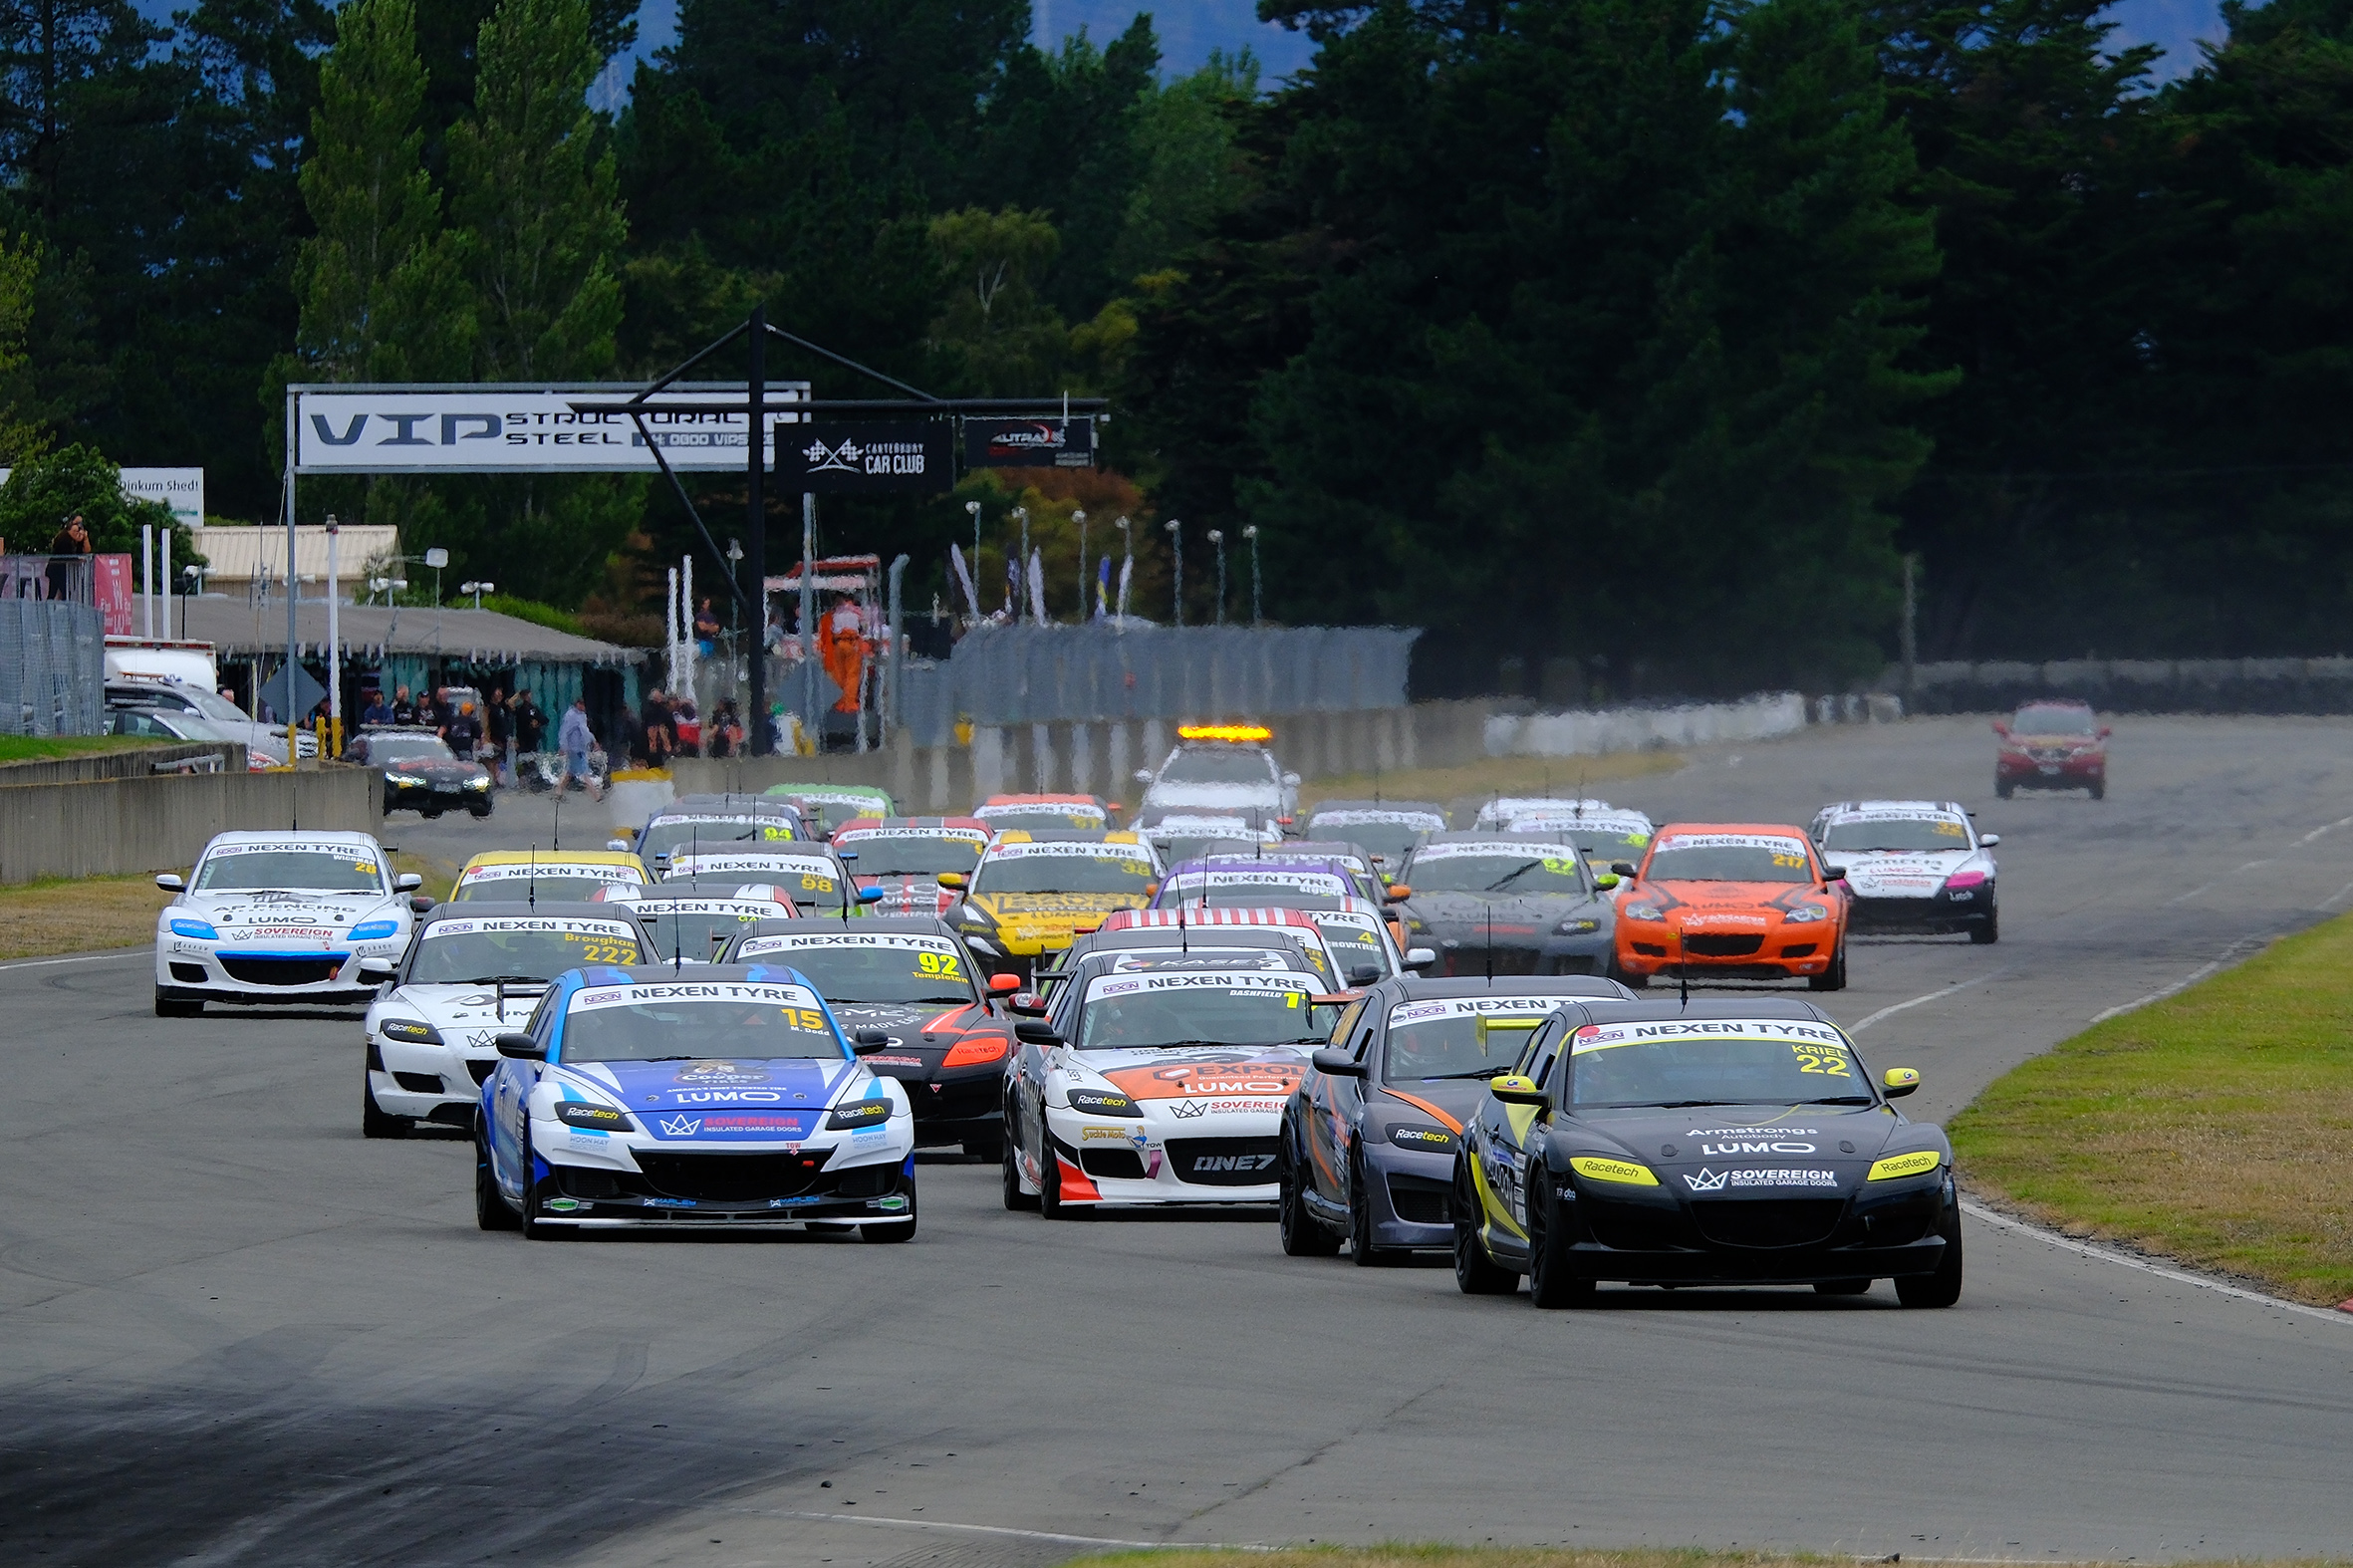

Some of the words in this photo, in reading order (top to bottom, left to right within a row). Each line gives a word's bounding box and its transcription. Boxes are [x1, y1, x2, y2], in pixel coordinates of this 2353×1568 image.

[506, 412, 743, 424] STRUCURAL
[310, 412, 502, 445] VIP
[506, 432, 624, 445] STEEL
[865, 455, 891, 474] CAR
[894, 455, 924, 474] CLUB
[166, 479, 199, 492] Shed!
[764, 827, 792, 841] 94
[936, 829, 978, 839] TYRE
[248, 844, 308, 853] NEXEN
[312, 844, 360, 856] TYRE
[1752, 839, 1794, 848] TYRE
[1028, 846, 1087, 855] NEXEN
[1093, 847, 1138, 857] TYRE
[710, 862, 771, 871] NEXEN
[775, 863, 824, 874] TYRE
[1771, 854, 1805, 869] 217
[355, 862, 378, 875] 28
[508, 868, 572, 877] NEXEN
[577, 868, 628, 880] TYRE
[801, 879, 833, 893] 98
[1212, 874, 1279, 884] NEXEN
[1282, 876, 1335, 888] TYRE
[253, 904, 357, 913] FENCING
[637, 904, 709, 913] NEXEN
[714, 905, 772, 916] TYRE
[253, 927, 334, 937] SOVEREIGN
[482, 920, 557, 930] NEXEN
[563, 921, 622, 934] TYRE
[565, 932, 637, 948] Broughan
[791, 935, 877, 946] NEXEN
[883, 936, 951, 951] TYRE
[1358, 931, 1375, 944] 4
[583, 944, 638, 965] 222
[917, 952, 960, 976] 92
[912, 971, 969, 984] Templeton
[1148, 976, 1233, 988] NEXEN
[1238, 976, 1306, 989] TYRE
[632, 986, 719, 999] NEXEN
[726, 986, 798, 1001] TYRE
[1229, 989, 1282, 998] DASHFIELD
[1456, 999, 1548, 1012] NEXEN
[781, 1008, 824, 1030] 15
[855, 1020, 896, 1030] MADE
[387, 1022, 428, 1035] Racetech
[804, 1027, 830, 1036] Dodd
[1635, 1023, 1744, 1037] NEXEN
[1751, 1024, 1839, 1042] TYRE
[1792, 1044, 1849, 1059] KRIEL
[1196, 1065, 1305, 1076] EXPOL
[1796, 1054, 1852, 1077] 22
[681, 1071, 764, 1081] Cooper
[1183, 1082, 1285, 1094] LUMO
[677, 1091, 781, 1104] LUMO
[1076, 1094, 1127, 1108] Racetech
[837, 1104, 886, 1120] Racetech
[1210, 1101, 1285, 1110] SOVEREIG
[567, 1107, 620, 1121] Racetech
[703, 1117, 799, 1127] SOVEREIGN
[1395, 1129, 1449, 1144] Racetech
[1686, 1128, 1819, 1137] Armstrongs
[1701, 1142, 1816, 1156] LUMO
[1583, 1159, 1640, 1177] Racetech
[1880, 1155, 1933, 1173] Racetech
[1730, 1169, 1835, 1179] SOVEREIGN
